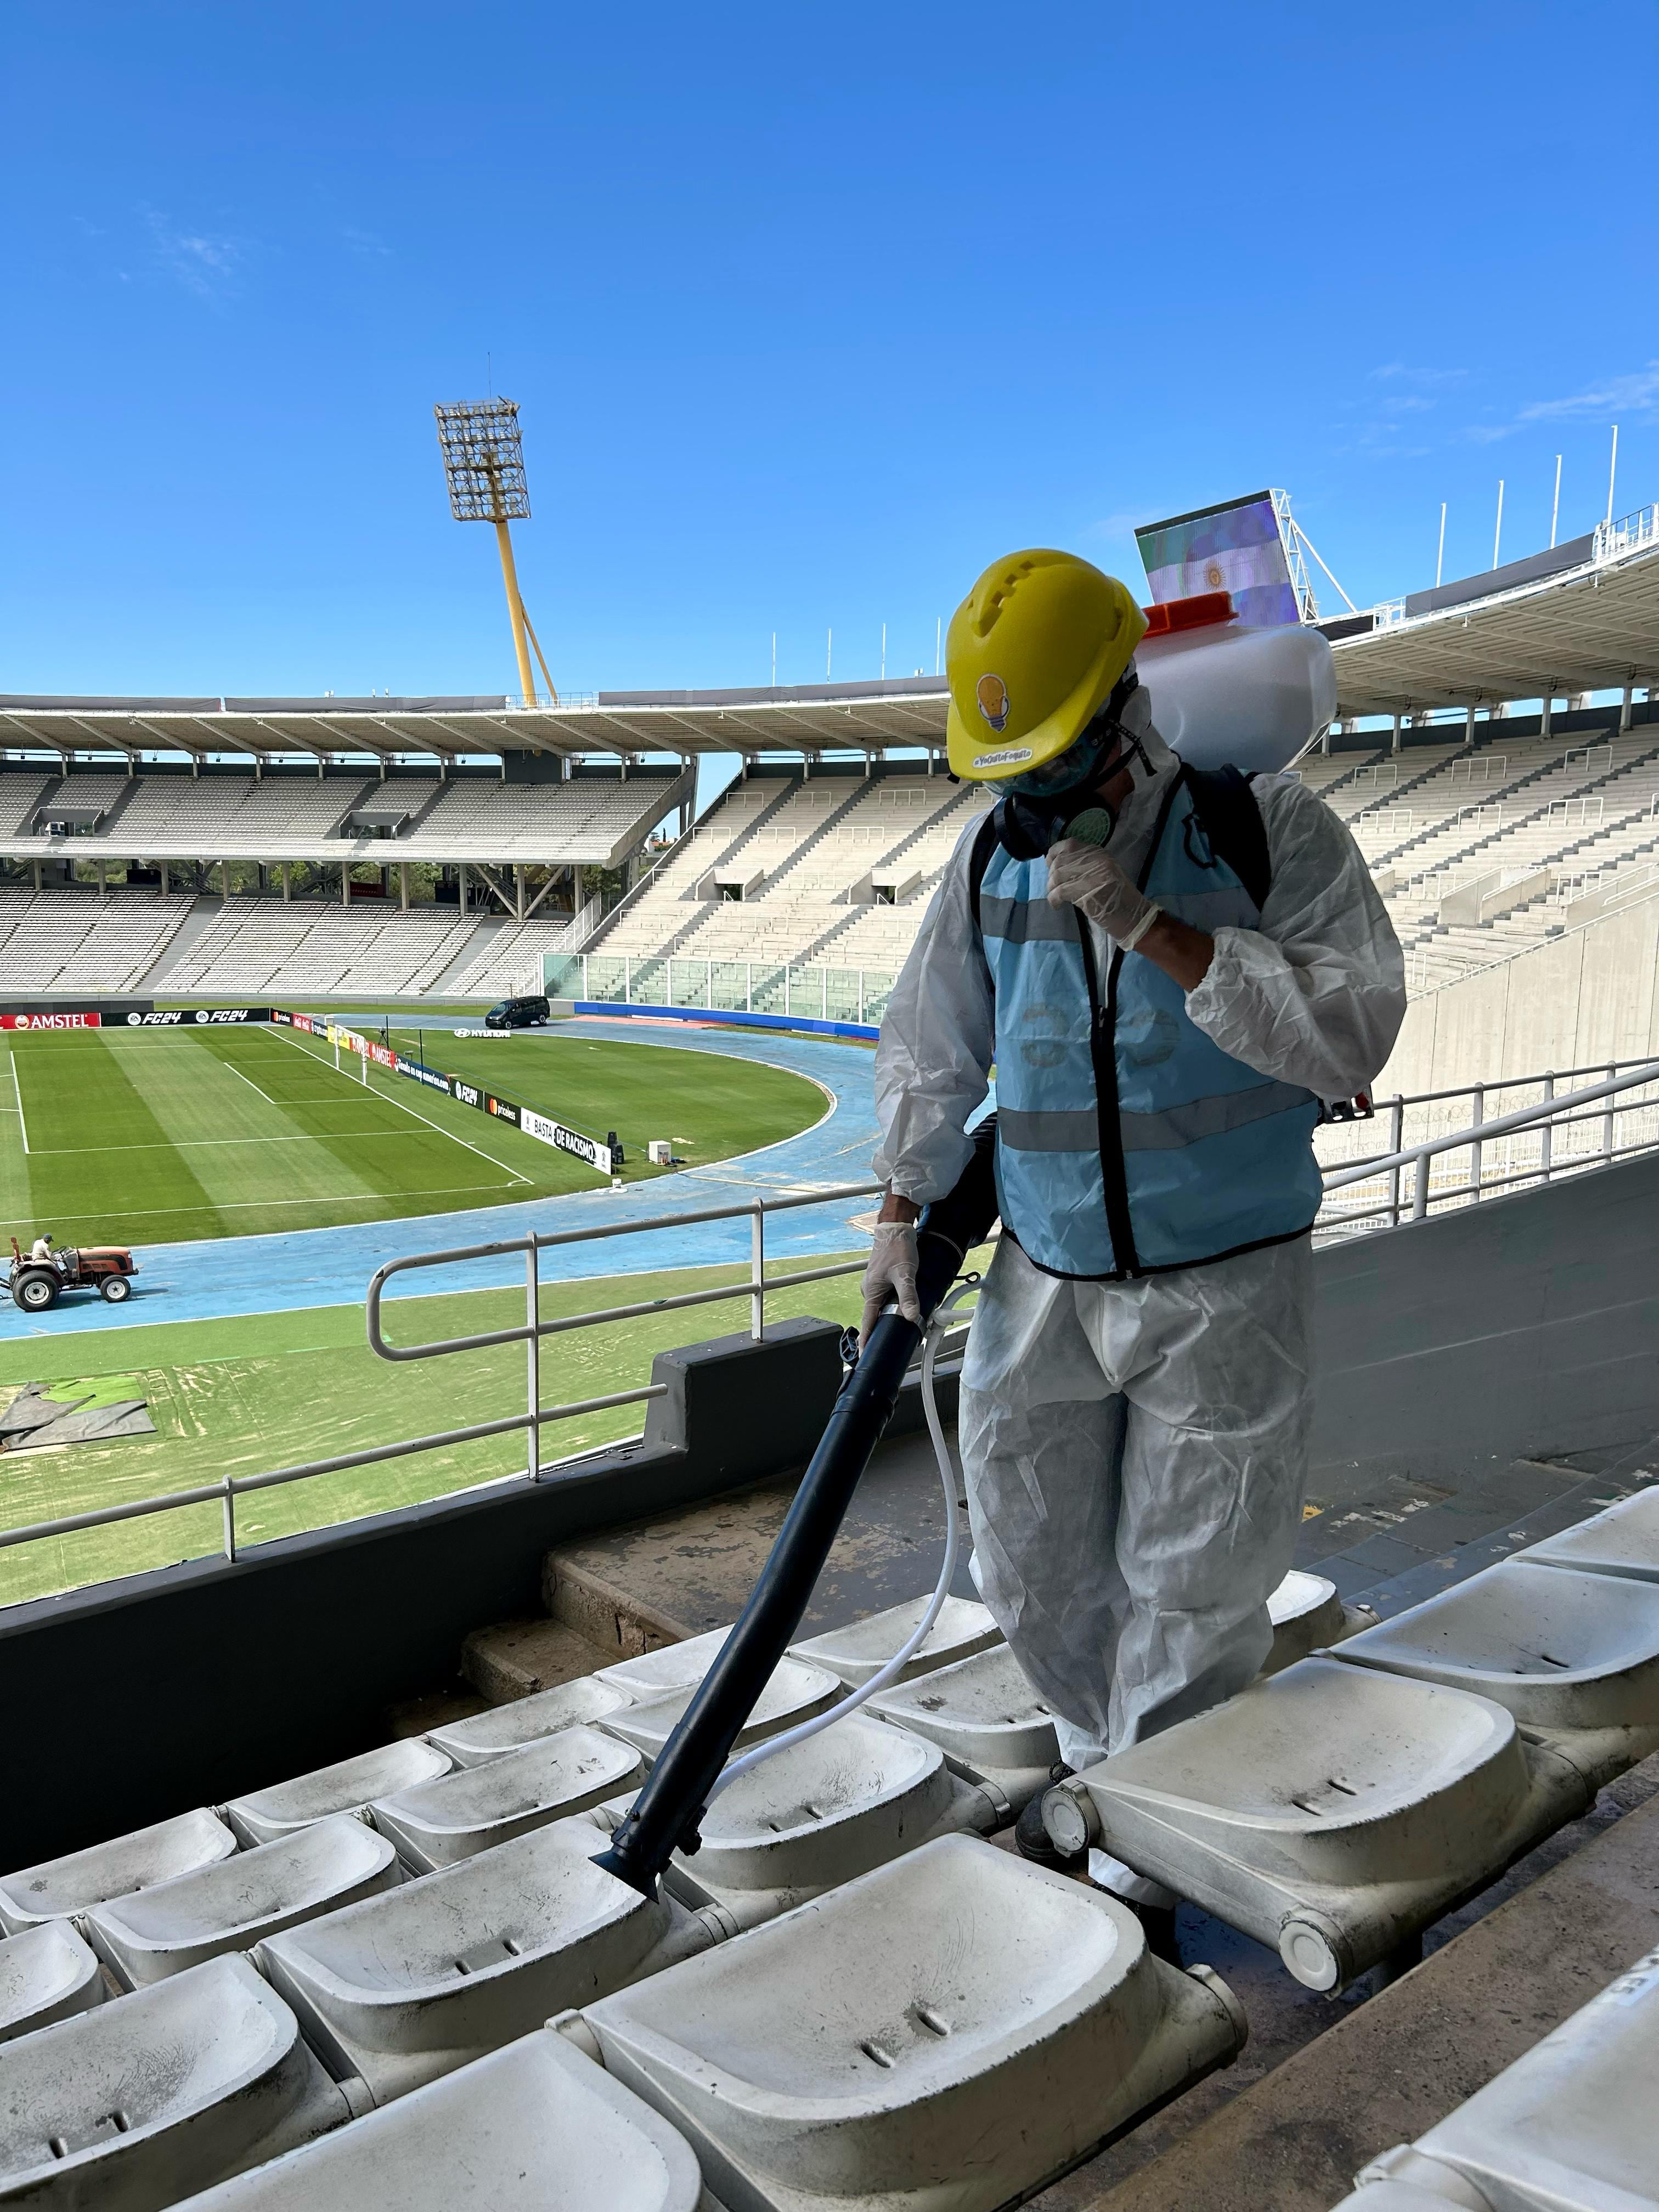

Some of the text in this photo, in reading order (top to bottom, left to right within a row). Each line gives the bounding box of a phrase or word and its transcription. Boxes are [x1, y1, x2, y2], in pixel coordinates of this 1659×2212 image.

[31, 1014, 89, 1029] AMSTEL
[142, 1012, 182, 1024] FC24
[210, 1009, 249, 1022] FC24
[471, 1029, 511, 1038] HYUNDAI
[376, 1046, 392, 1068] AMSTEL
[461, 1085, 478, 1106] FC24
[498, 1103, 516, 1120] priceless
[534, 1119, 594, 1161] BASTA DE RACISMO
